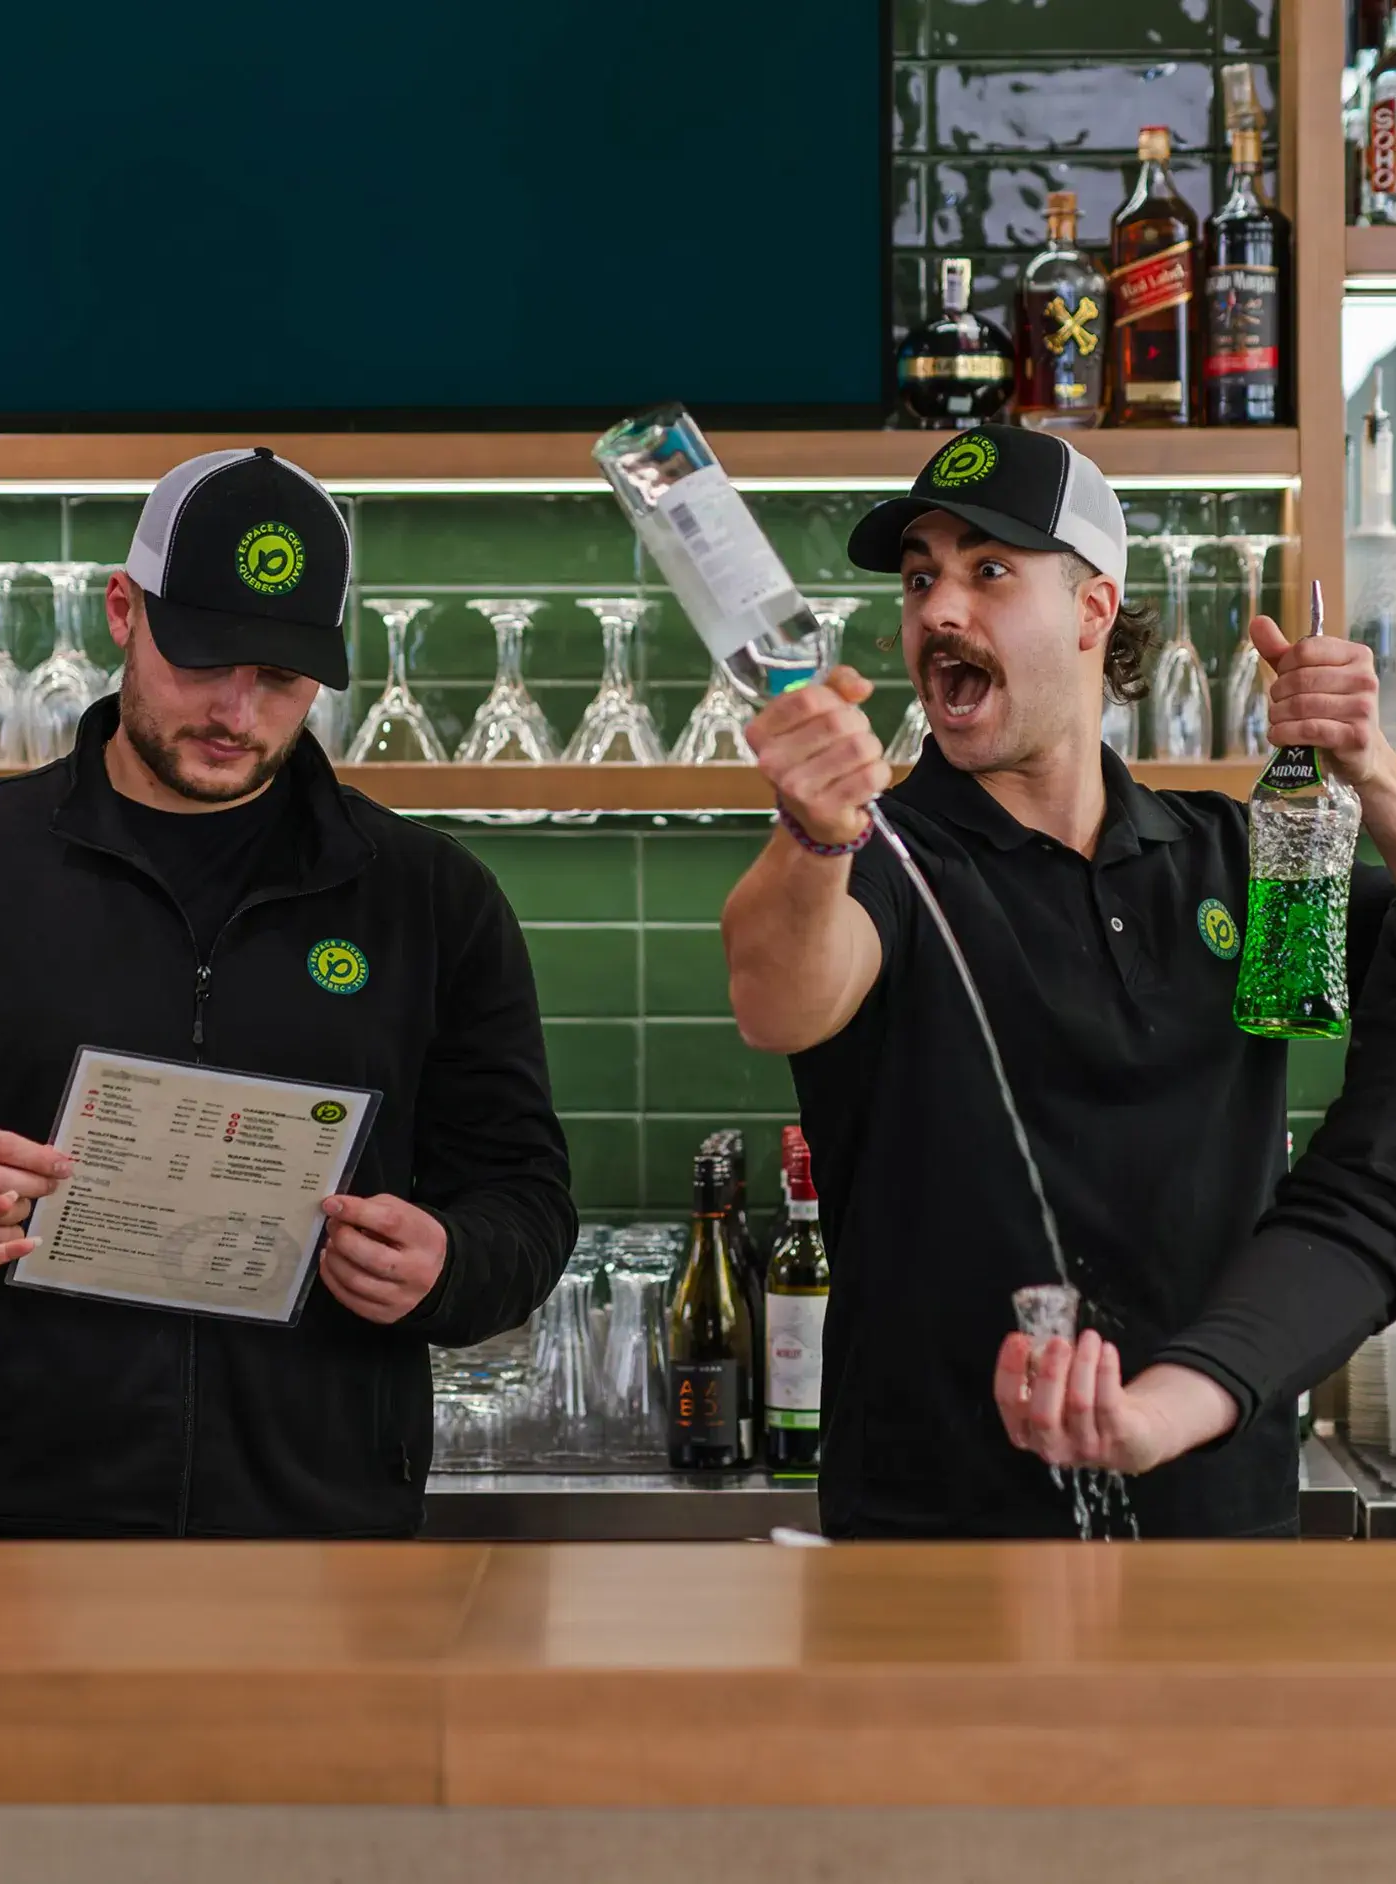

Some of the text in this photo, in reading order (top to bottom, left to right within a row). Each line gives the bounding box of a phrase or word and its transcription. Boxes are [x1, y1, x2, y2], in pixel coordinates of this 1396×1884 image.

[1375, 107, 1394, 190] SOHO
[238, 523, 304, 588] ESPACE PICKLEBALL
[239, 563, 275, 593] QUEBEC
[1268, 765, 1314, 778] MIDORI
[340, 941, 366, 987] PICKLEBALL
